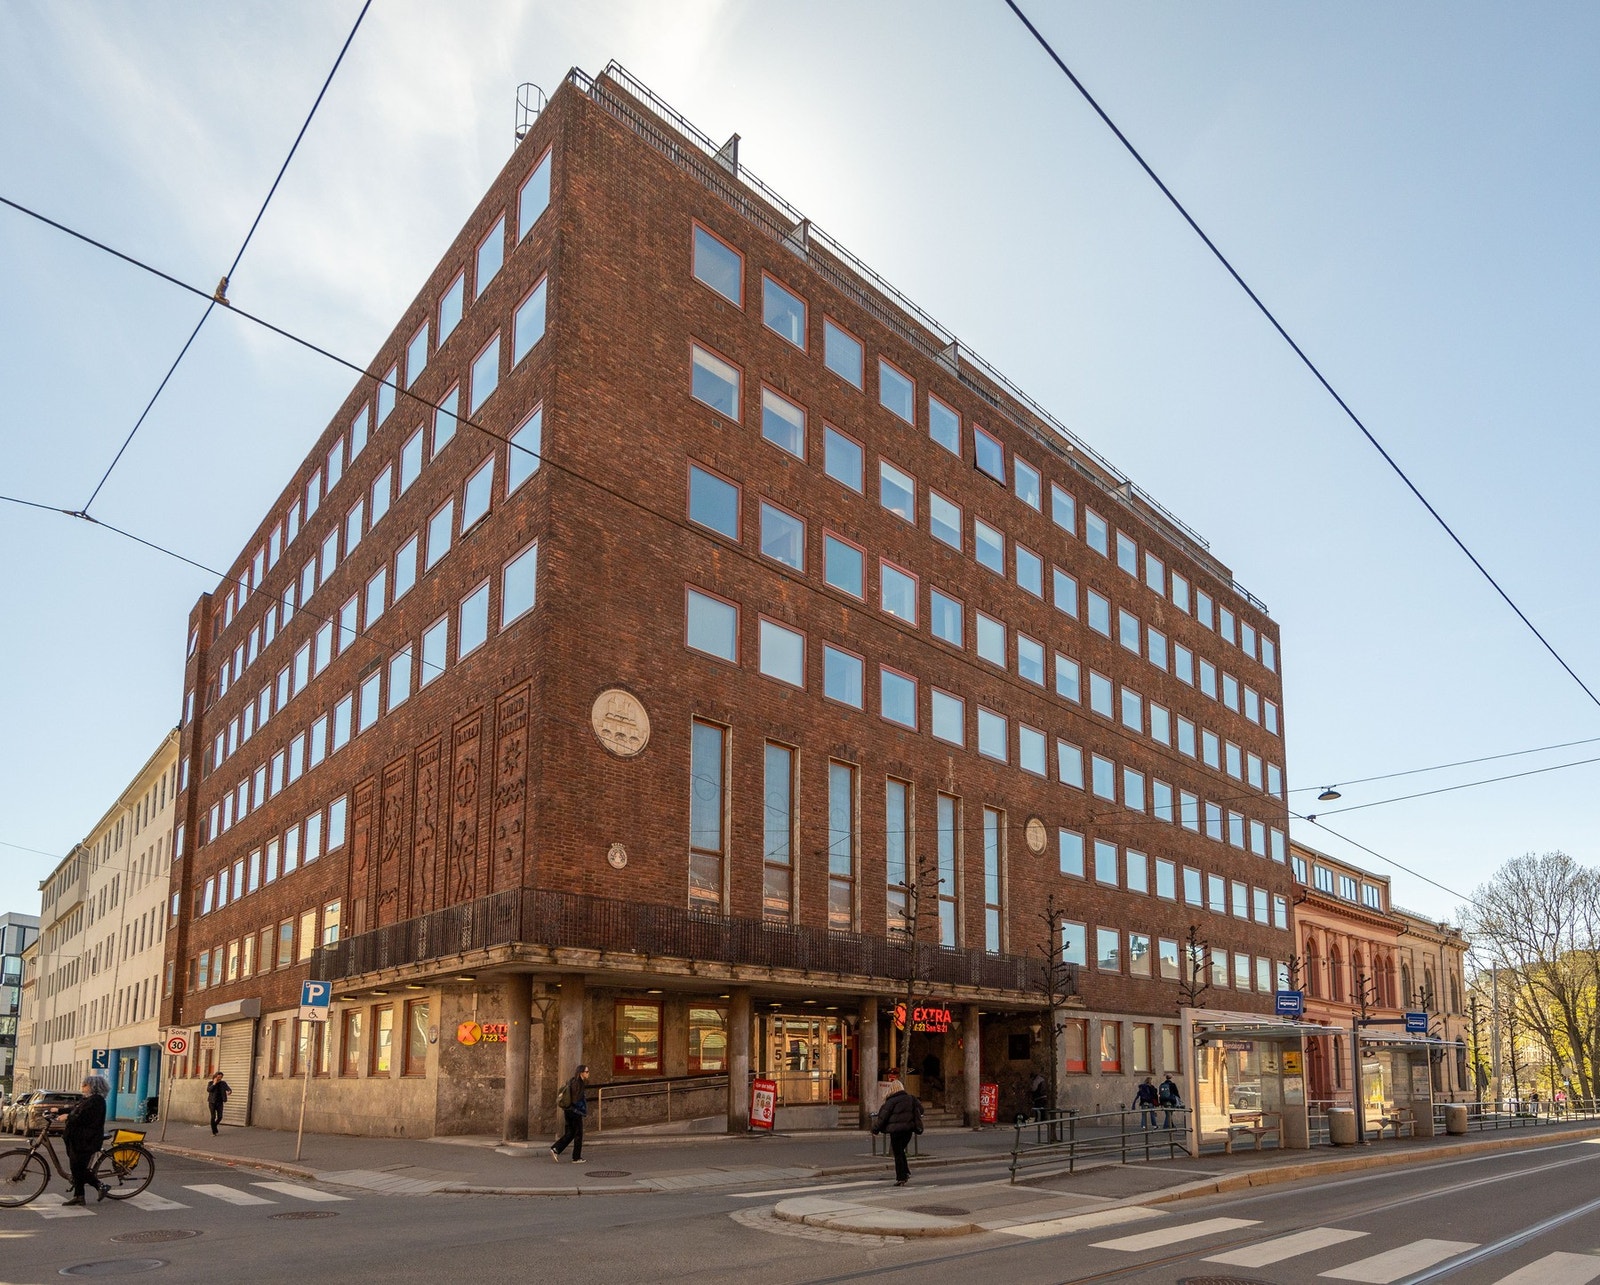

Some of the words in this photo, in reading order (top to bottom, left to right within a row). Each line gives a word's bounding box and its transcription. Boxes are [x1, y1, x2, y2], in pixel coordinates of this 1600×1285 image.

[307, 984, 325, 1003] P
[913, 1007, 952, 1023] EXTRA
[204, 1024, 213, 1035] P
[482, 1034, 498, 1042] 7-23
[171, 1041, 183, 1049] 30
[96, 1050, 106, 1060] P
[775, 1049, 782, 1060] 5
